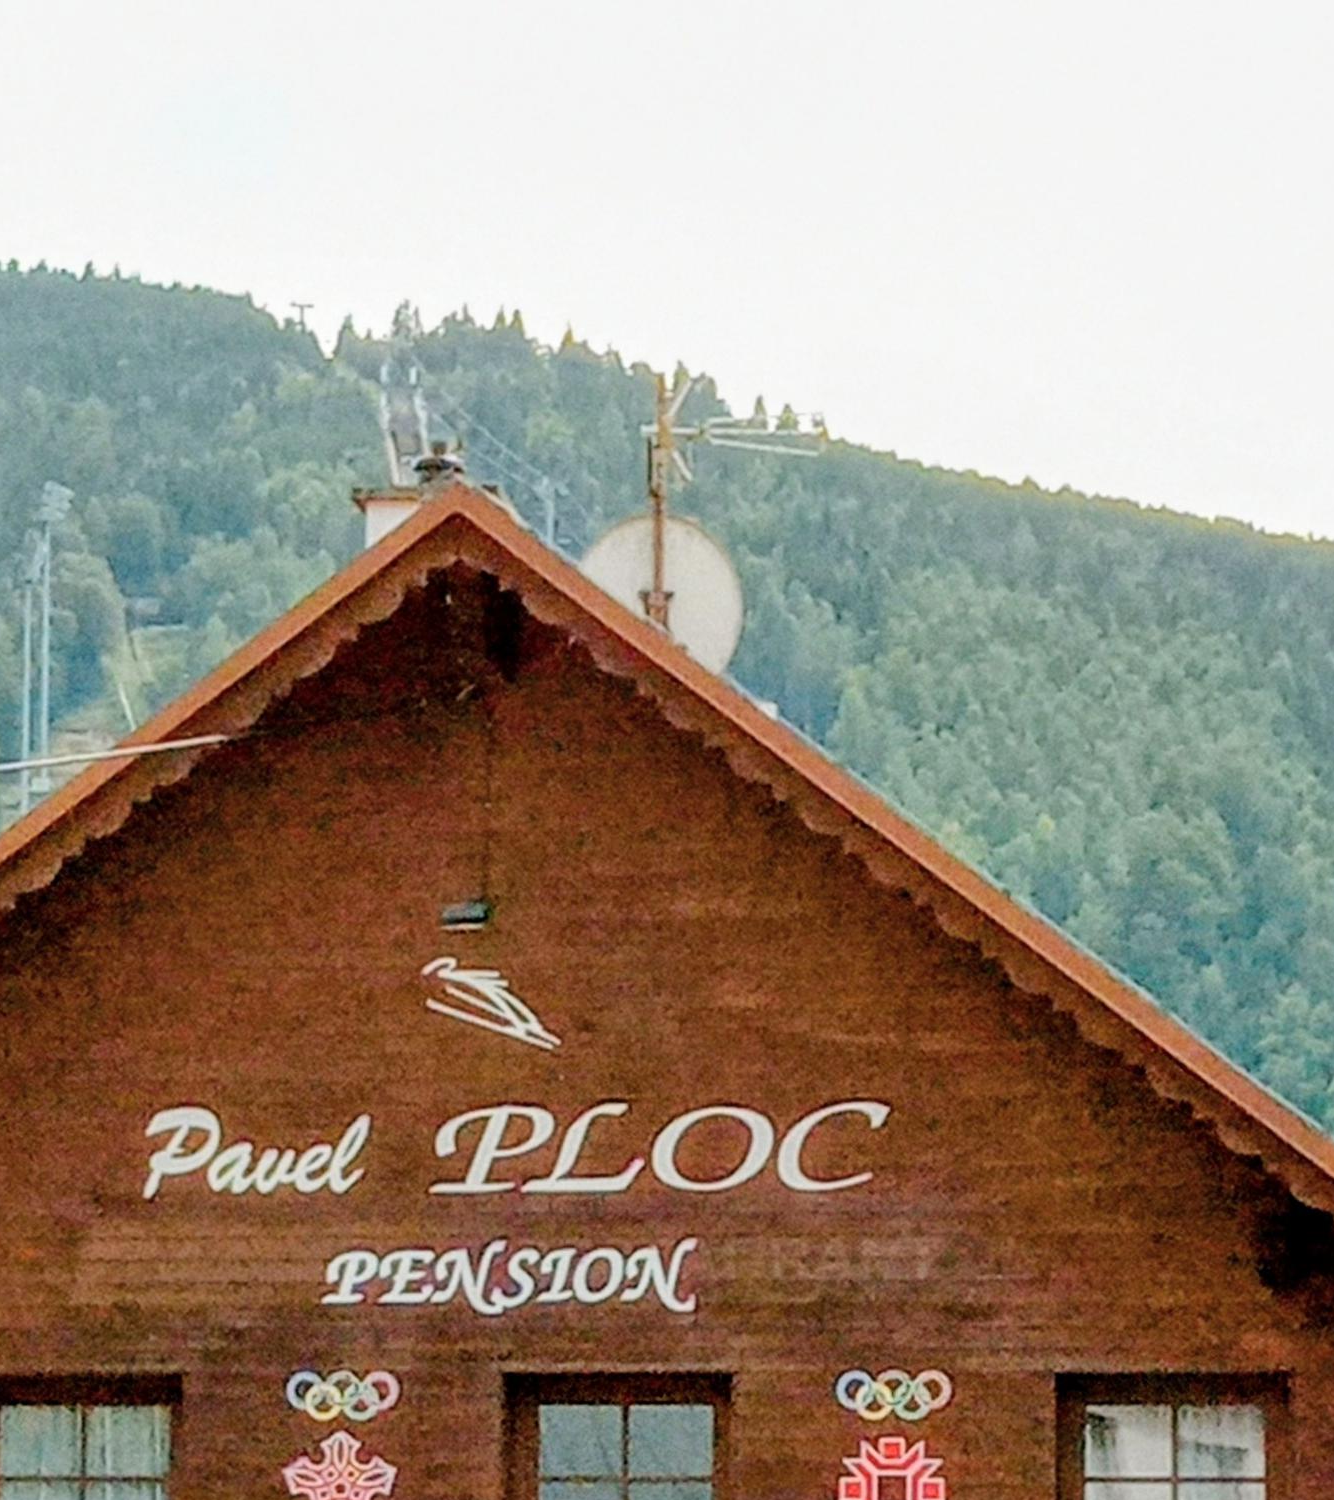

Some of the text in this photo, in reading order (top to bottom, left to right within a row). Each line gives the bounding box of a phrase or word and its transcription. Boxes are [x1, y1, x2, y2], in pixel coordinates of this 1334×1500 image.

[144, 1101, 891, 1199] Pavel PLOC
[322, 1238, 698, 1314] PENSION
